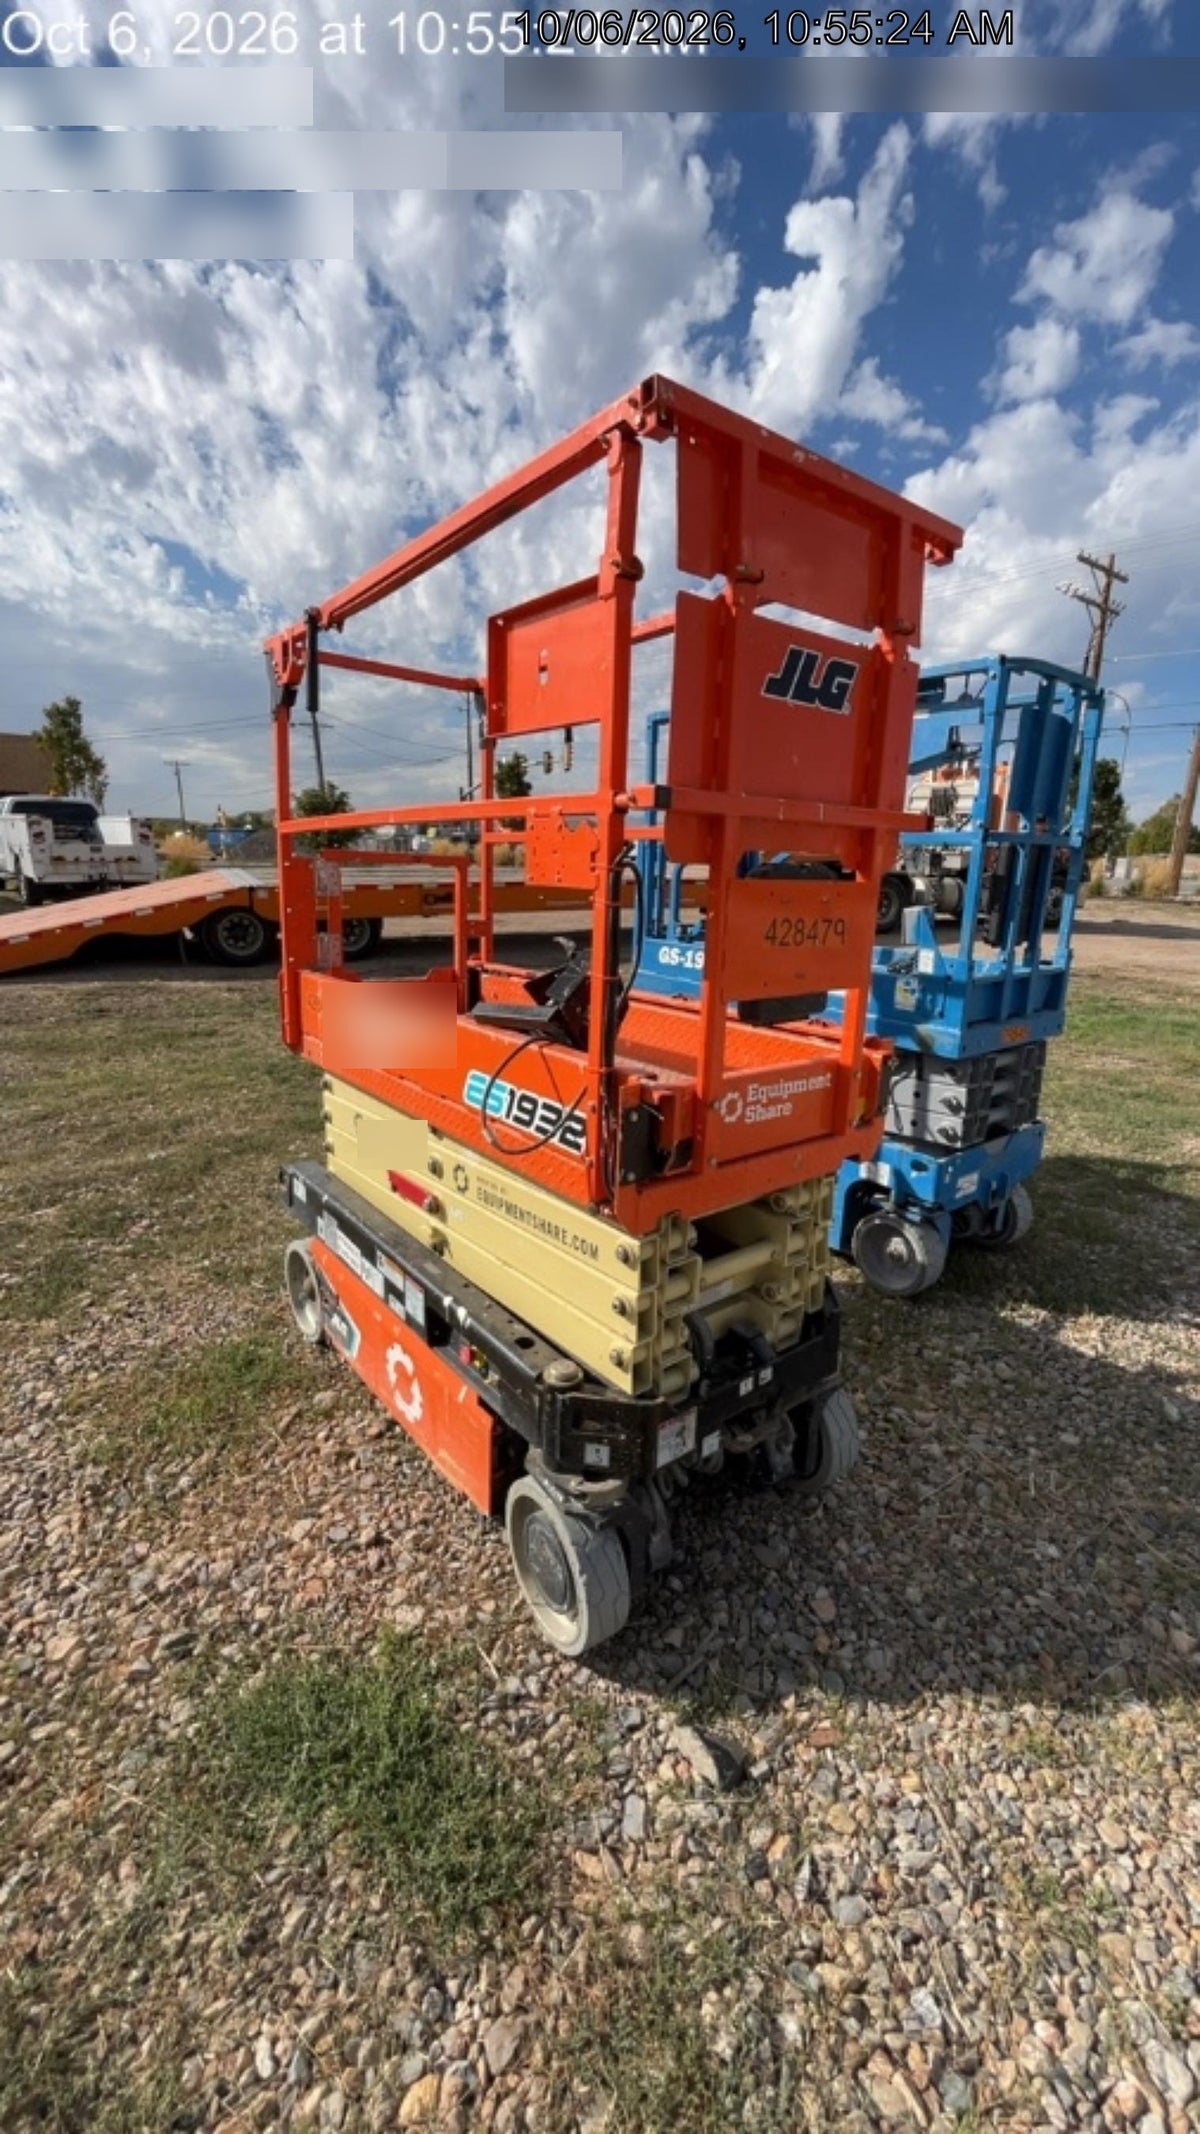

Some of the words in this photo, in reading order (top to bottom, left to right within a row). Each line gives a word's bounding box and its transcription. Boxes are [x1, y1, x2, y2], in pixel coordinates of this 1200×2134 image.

[761, 644, 860, 714] JLG
[764, 917, 846, 948] 428479
[464, 1069, 587, 1156] ES1932
[746, 1072, 831, 1103] Equipment
[744, 1102, 793, 1125] Share
[476, 1186, 599, 1261] EQUIPMENTSHARE.COM
